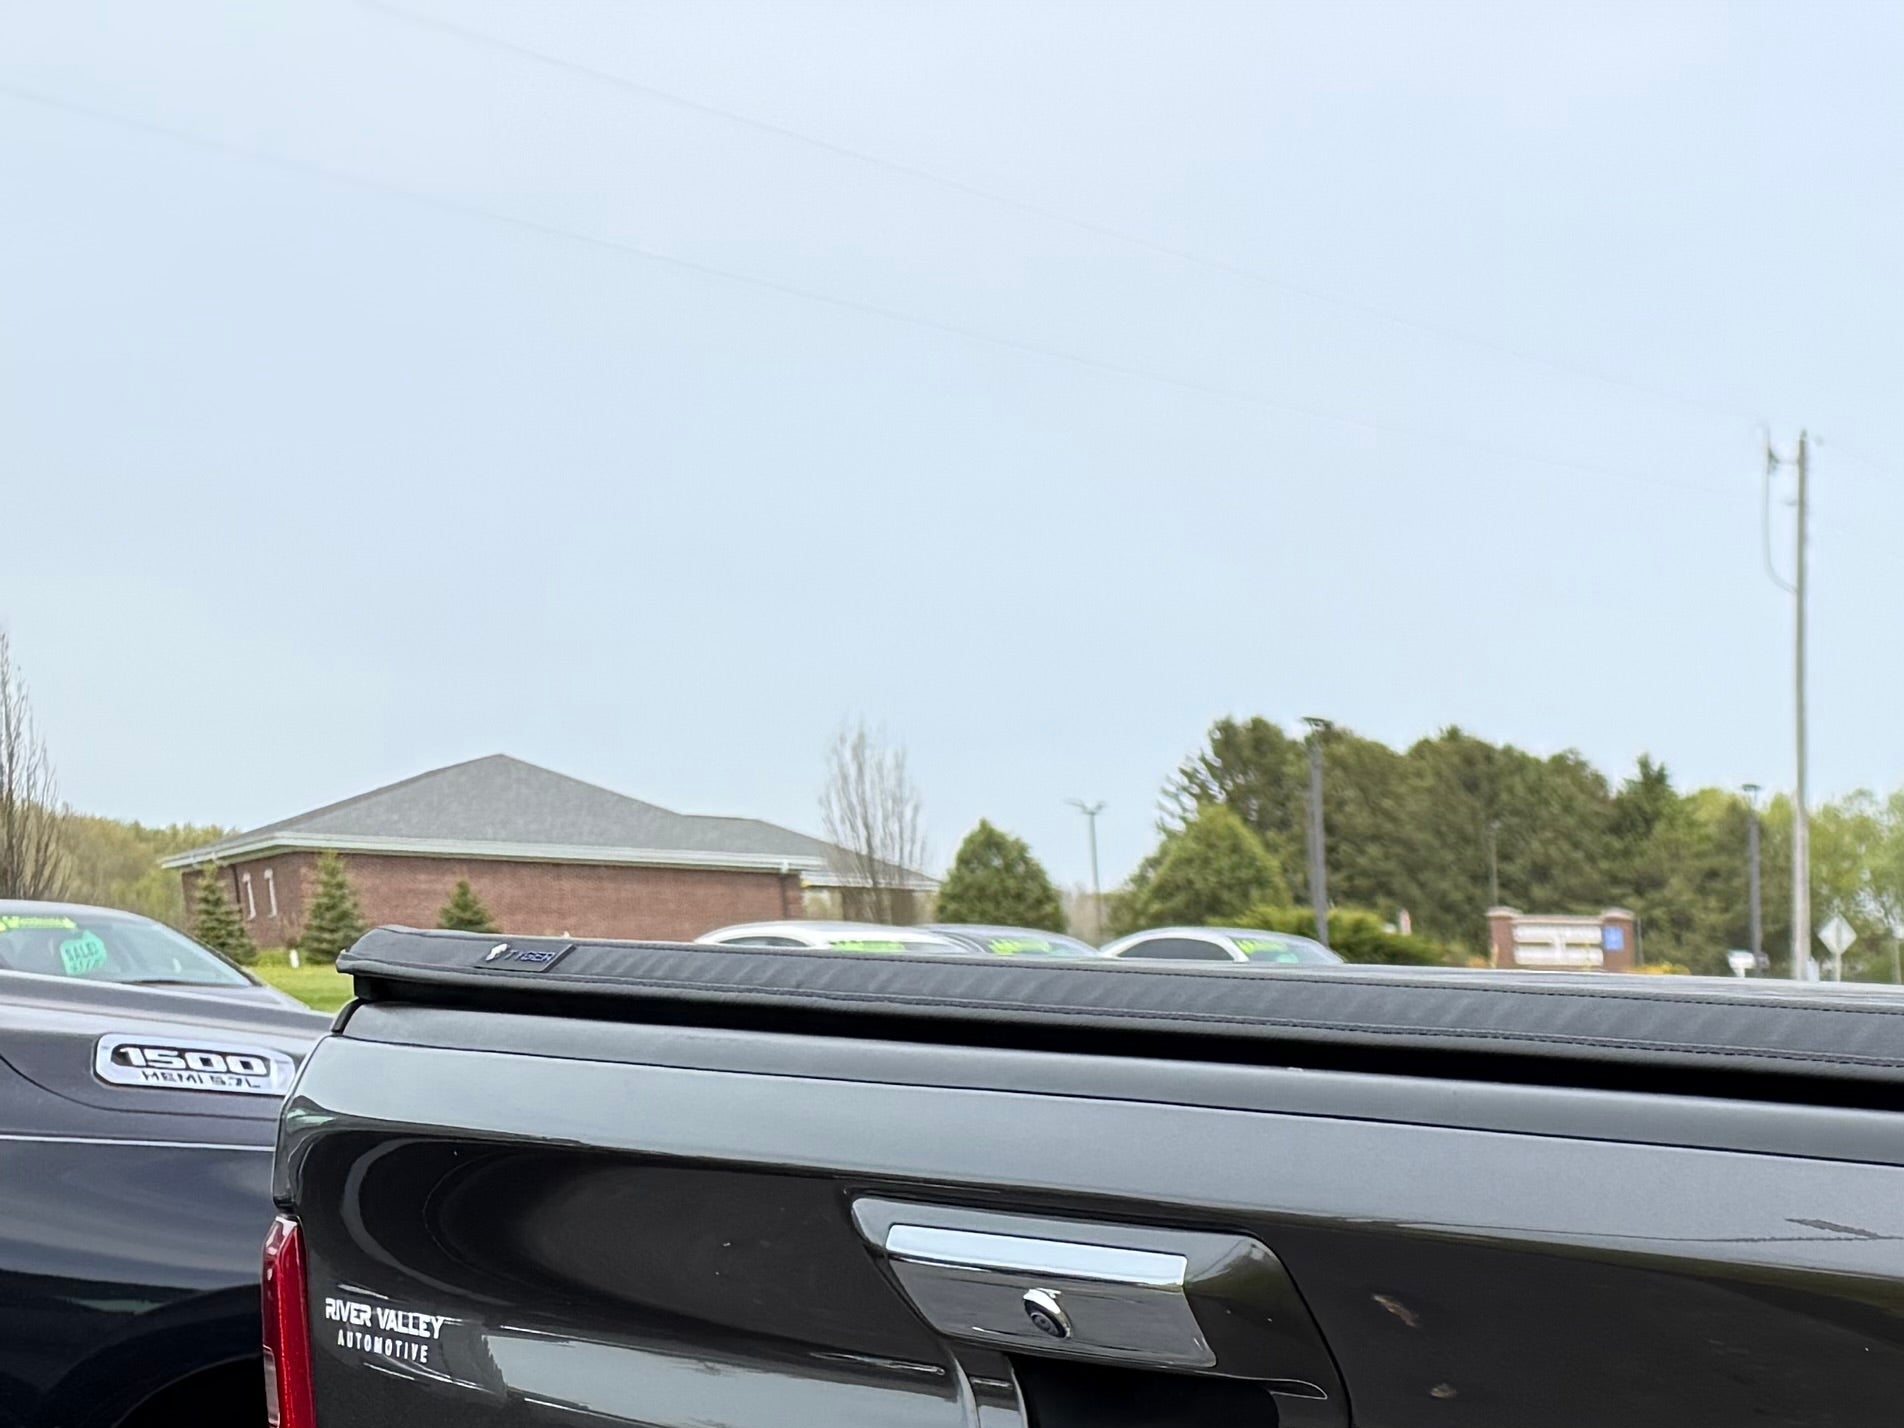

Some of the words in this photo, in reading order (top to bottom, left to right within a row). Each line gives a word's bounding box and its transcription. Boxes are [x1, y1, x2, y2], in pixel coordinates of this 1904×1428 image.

[119, 1047, 268, 1076] 1500
[141, 1070, 204, 1086] HEMI
[325, 1297, 372, 1328] RIVER
[376, 1306, 444, 1339] VALLEY
[337, 1328, 429, 1363] AUTOMOTIVE
